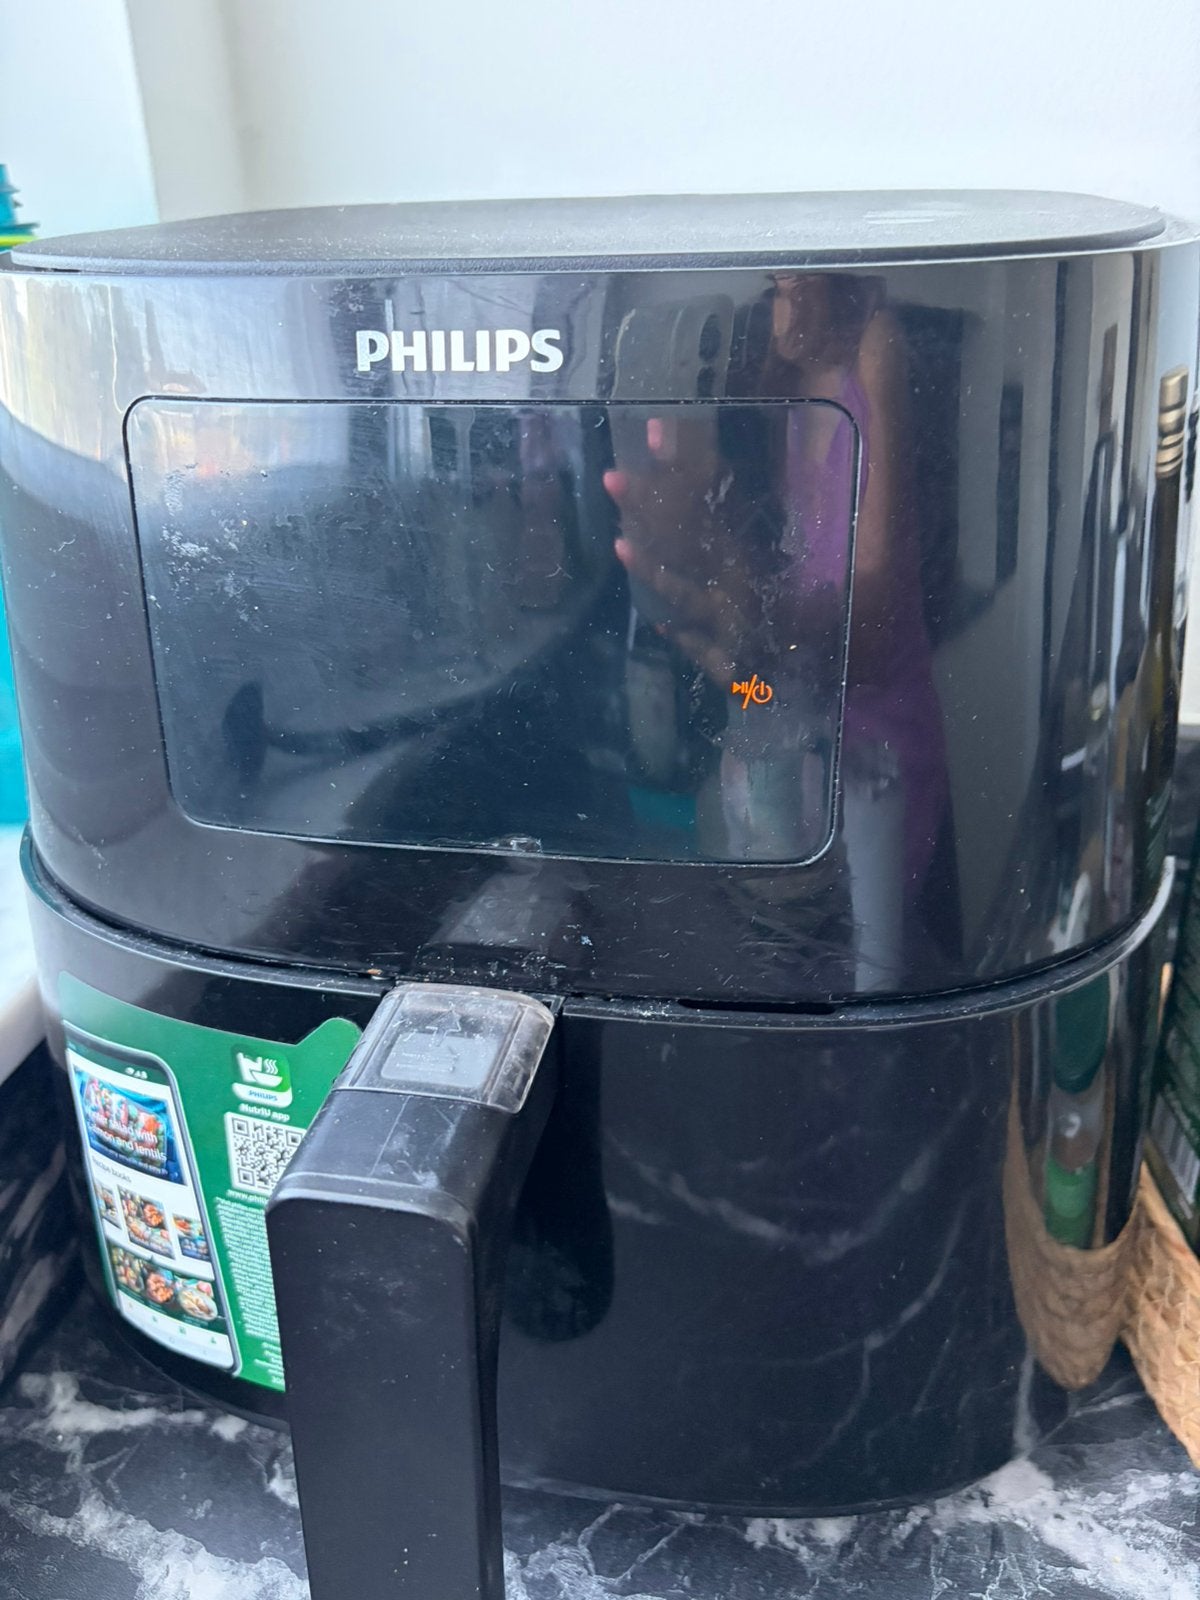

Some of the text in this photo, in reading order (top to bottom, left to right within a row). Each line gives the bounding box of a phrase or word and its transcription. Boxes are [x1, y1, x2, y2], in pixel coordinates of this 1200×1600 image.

[356, 329, 563, 372] PHILIPS
[248, 1089, 278, 1101] PHILIPS
[272, 1111, 290, 1124] app
